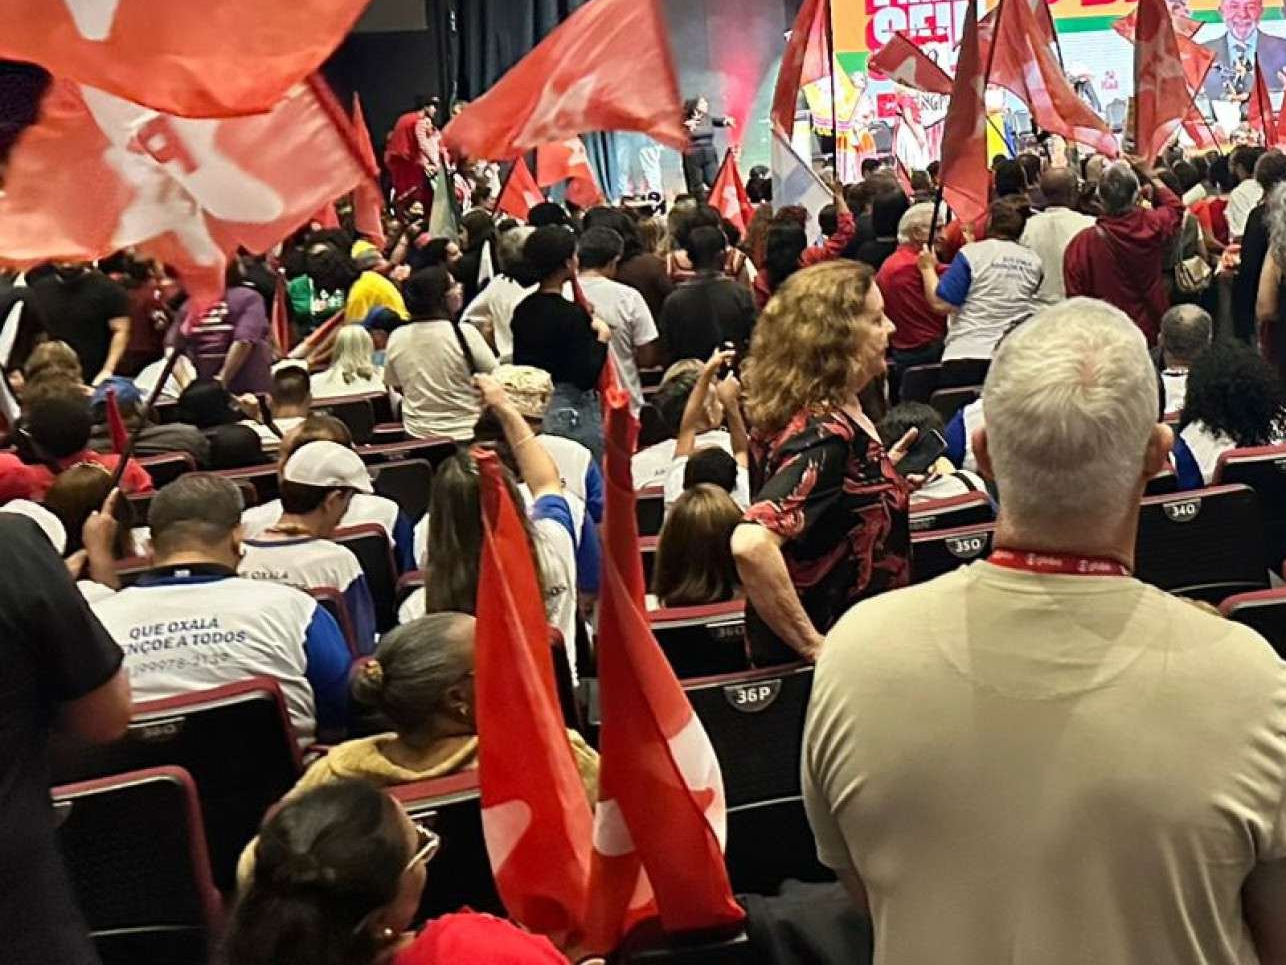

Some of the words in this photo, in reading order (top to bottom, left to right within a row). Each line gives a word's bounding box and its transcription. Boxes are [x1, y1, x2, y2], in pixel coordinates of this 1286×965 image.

[129, 622, 165, 640] QUE
[192, 630, 248, 646] TODOS
[736, 686, 771, 704] 36P
